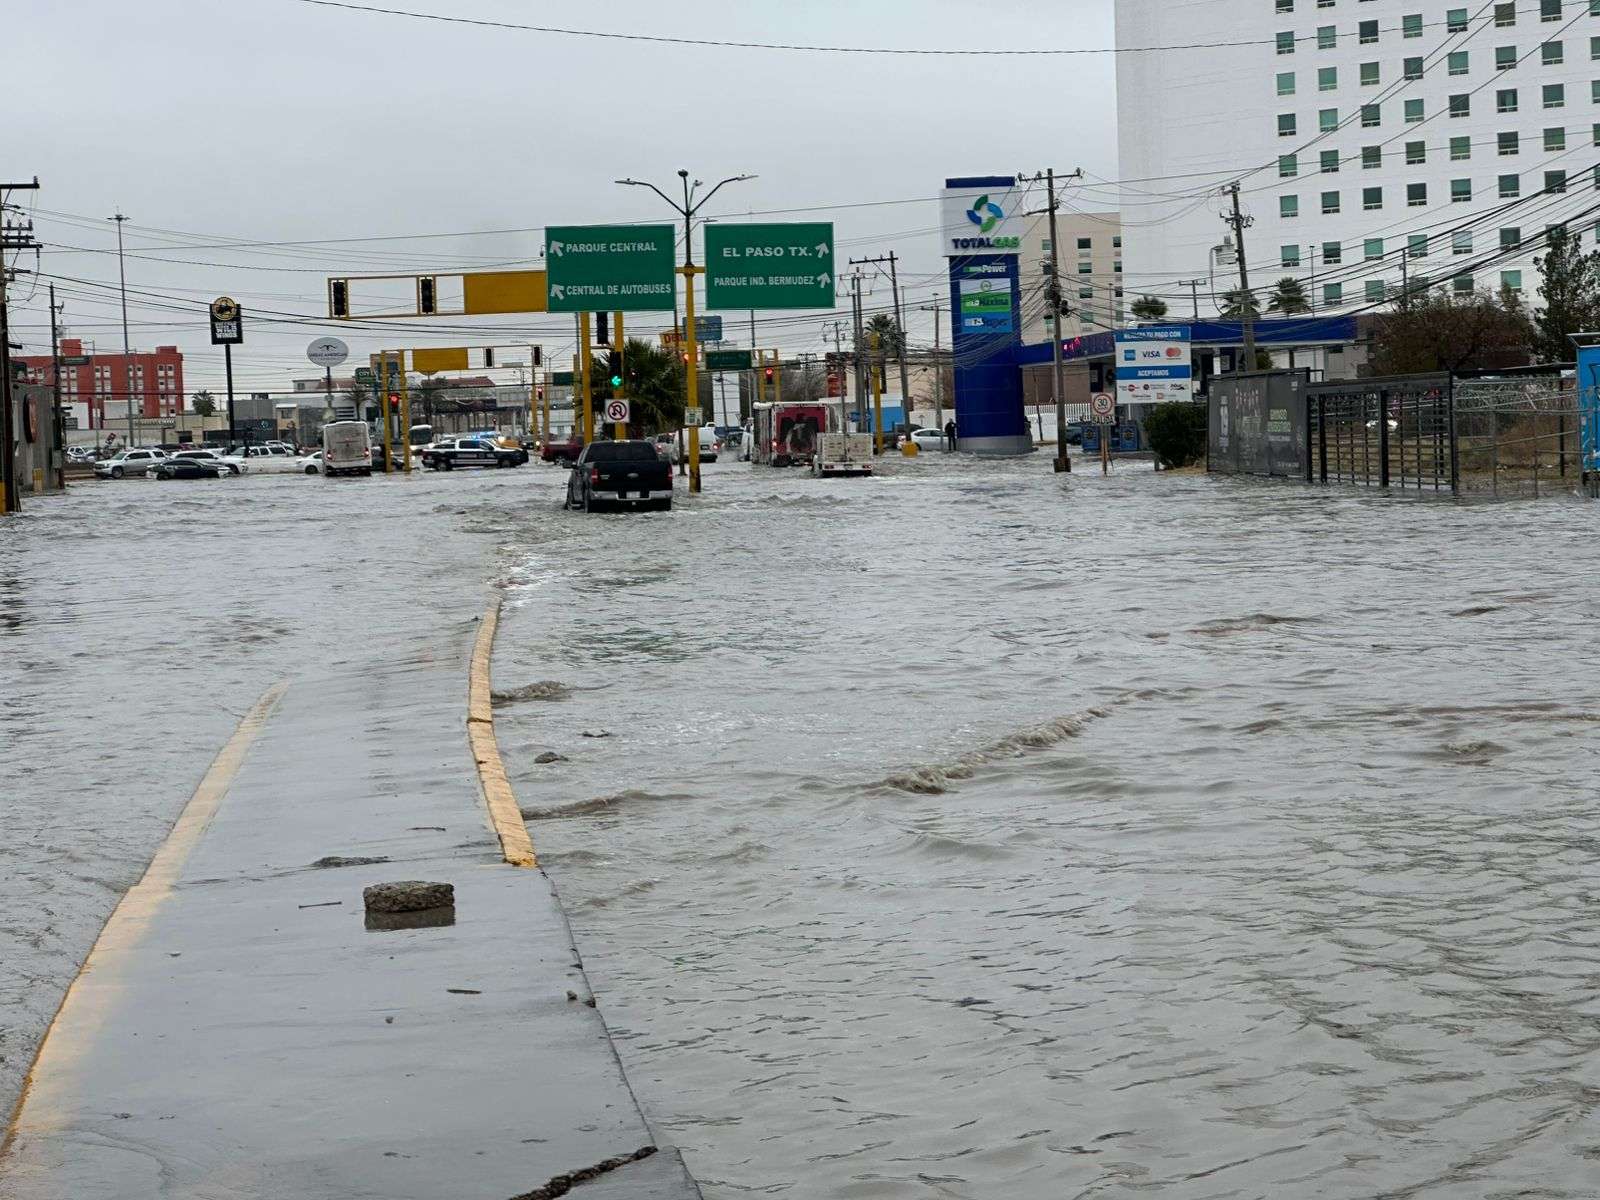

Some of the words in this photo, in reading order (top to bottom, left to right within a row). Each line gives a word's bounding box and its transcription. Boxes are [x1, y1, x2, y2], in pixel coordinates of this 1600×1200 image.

[566, 243, 607, 253] PARQUE
[610, 242, 657, 252] CENTRAL
[723, 247, 741, 257] EL
[745, 246, 784, 256] PASO
[788, 246, 813, 256] TX.
[714, 277, 748, 286] PARQUE
[750, 276, 767, 286] IND.
[769, 276, 815, 285] BERMUDEZ
[566, 285, 605, 295] CENTRAL
[607, 285, 619, 294] DE
[621, 284, 672, 294] AUTOBUSES
[1142, 350, 1160, 358] VISA
[1137, 369, 1169, 377] ACEPTAMOS
[1097, 398, 1108, 406] 30
